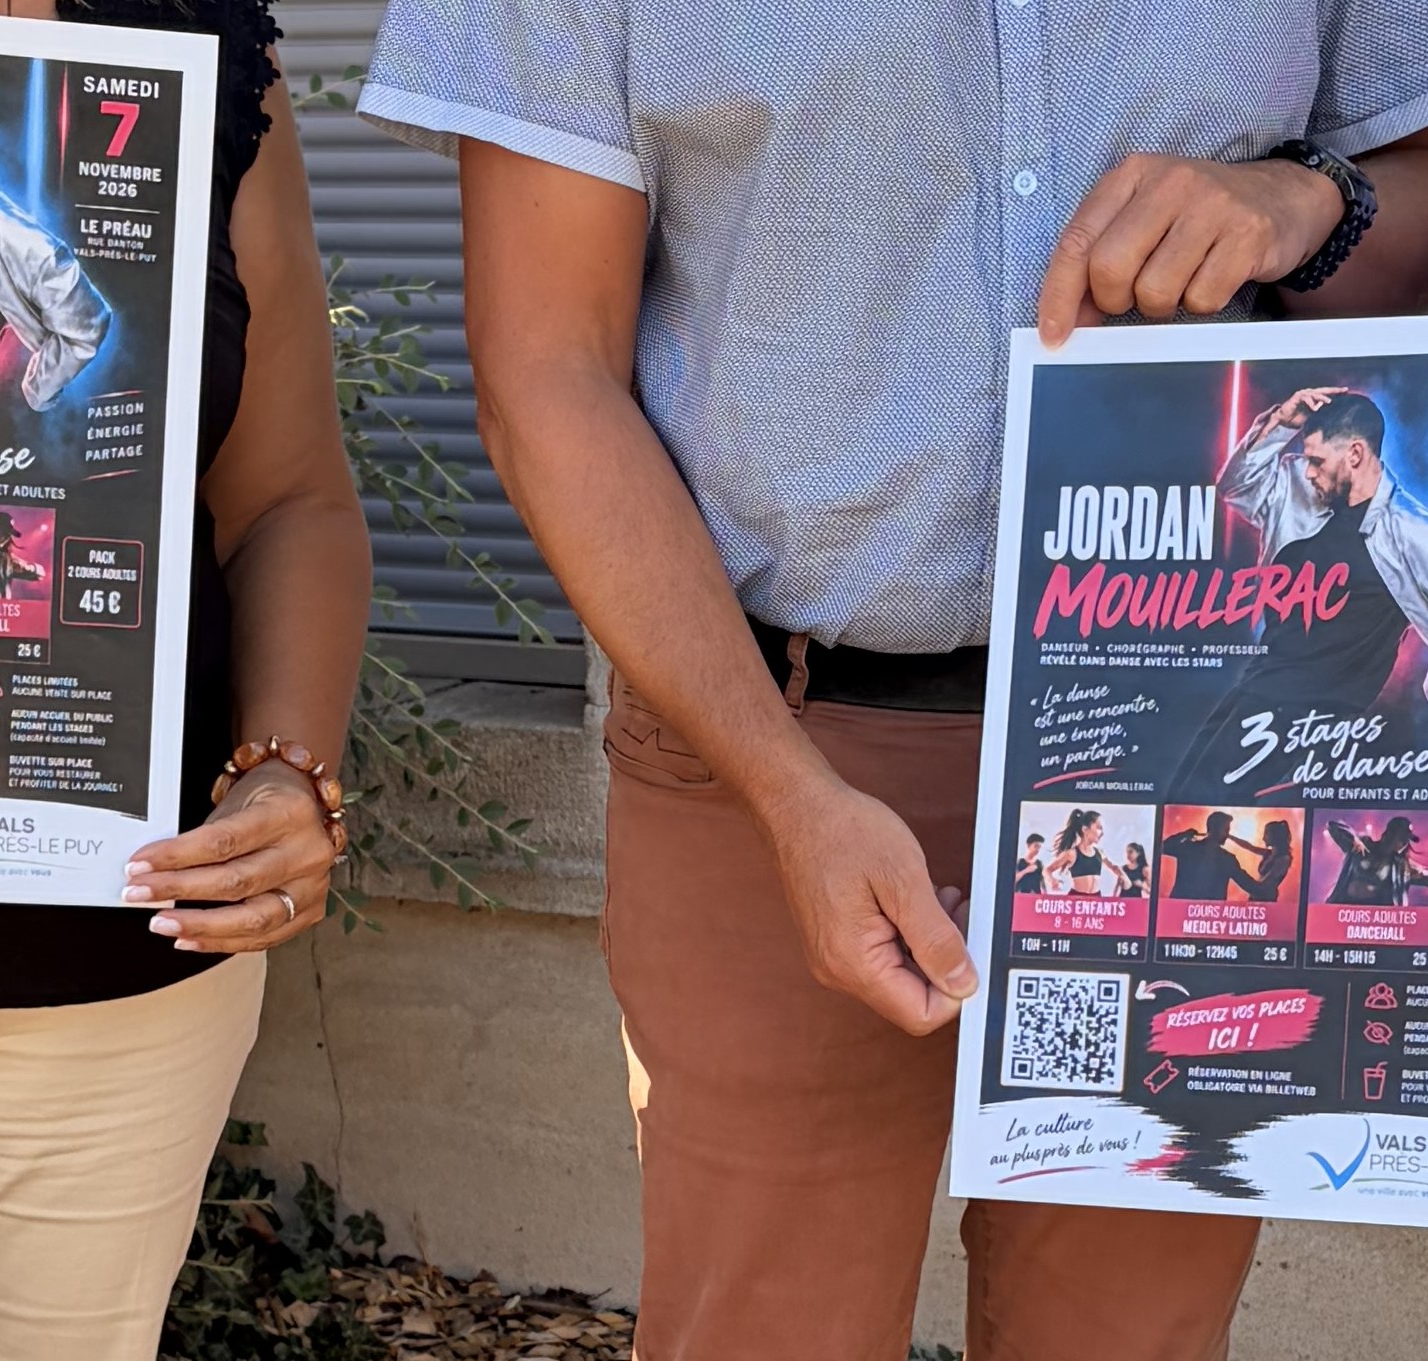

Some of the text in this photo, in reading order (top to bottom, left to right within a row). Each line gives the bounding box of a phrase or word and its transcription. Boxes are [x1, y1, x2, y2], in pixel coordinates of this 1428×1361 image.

[83, 75, 160, 99] SAMEDI
[100, 100, 140, 157] 7
[78, 161, 162, 183] NOVEMBRE
[97, 180, 138, 198] 2026
[80, 218, 152, 239] LE PRÉAU
[86, 397, 144, 419] PASSION
[87, 423, 144, 440] ÉNERGIE
[85, 444, 143, 462] PARTAGE
[12, 485, 66, 500] ADULTES
[1043, 484, 1217, 561] JORDAN
[89, 549, 116, 565] PACK
[79, 589, 121, 614] 45 €
[1033, 558, 1349, 638] MOUILLERAC
[17, 643, 41, 658] 25 €
[1041, 642, 1269, 655] DANSEUR CHORÉGRAPHE PROFESSEUR
[1039, 654, 1223, 668] RÉVÉLÉ DANS DANSE AVEC LES STARS
[1042, 682, 1111, 712] La danse
[1034, 692, 1160, 729] est une rencontre,
[1039, 722, 1127, 748] une énergie,
[1223, 709, 1387, 785] 3 stages
[1040, 740, 1126, 774] un partage.
[1292, 749, 1328, 784] de
[1302, 787, 1335, 799] POUR
[1338, 787, 1391, 800] ENFANTS
[1393, 788, 1409, 800] ET
[64, 838, 104, 856] PUY
[1034, 898, 1126, 917] COURS ENFANTS
[1187, 904, 1266, 920] COURS ADULTES
[1338, 909, 1417, 925] COURS ADULTES
[1182, 919, 1268, 937] MEDLEY LATINO
[1346, 925, 1406, 941] DANCEHALL
[1021, 937, 1041, 951] 10H
[1051, 939, 1071, 953] 11H
[1117, 941, 1139, 956] 15 €
[1164, 943, 1197, 958] 11H30
[1206, 945, 1238, 959] 12H45
[1263, 946, 1288, 962] 25 €
[1314, 949, 1334, 963] 14H
[1343, 950, 1376, 965] 15H15
[1412, 951, 1427, 966] 25
[1166, 997, 1307, 1033] RÉSERVEZ VOS PLACES
[1208, 1022, 1259, 1051] ICI !
[1005, 1112, 1094, 1142] La culture
[989, 1154, 1010, 1166] au
[1076, 1135, 1095, 1155] de
[1098, 1137, 1128, 1152] vous
[1133, 1130, 1142, 1150] !
[1375, 1133, 1427, 1153] VALS
